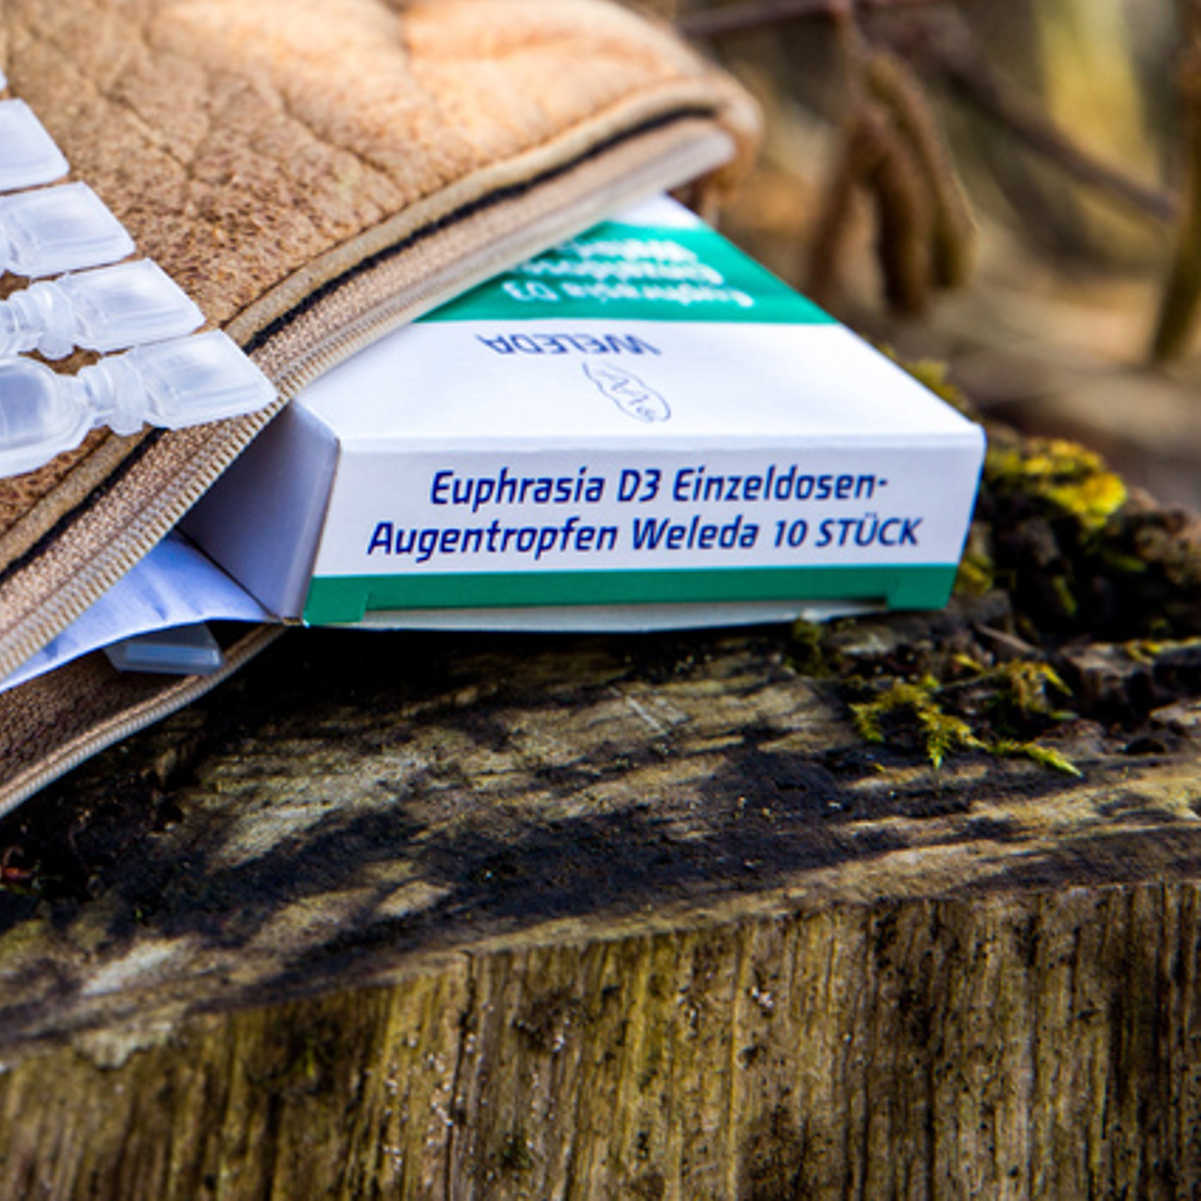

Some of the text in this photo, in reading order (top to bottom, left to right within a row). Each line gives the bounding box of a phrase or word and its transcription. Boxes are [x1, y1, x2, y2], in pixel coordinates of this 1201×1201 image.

[475, 333, 662, 356] WELEDA
[429, 464, 888, 513] Euphrasia D3 Einzeldosen-
[367, 511, 924, 564] Augentropfen Weleda 10 STÜCK
